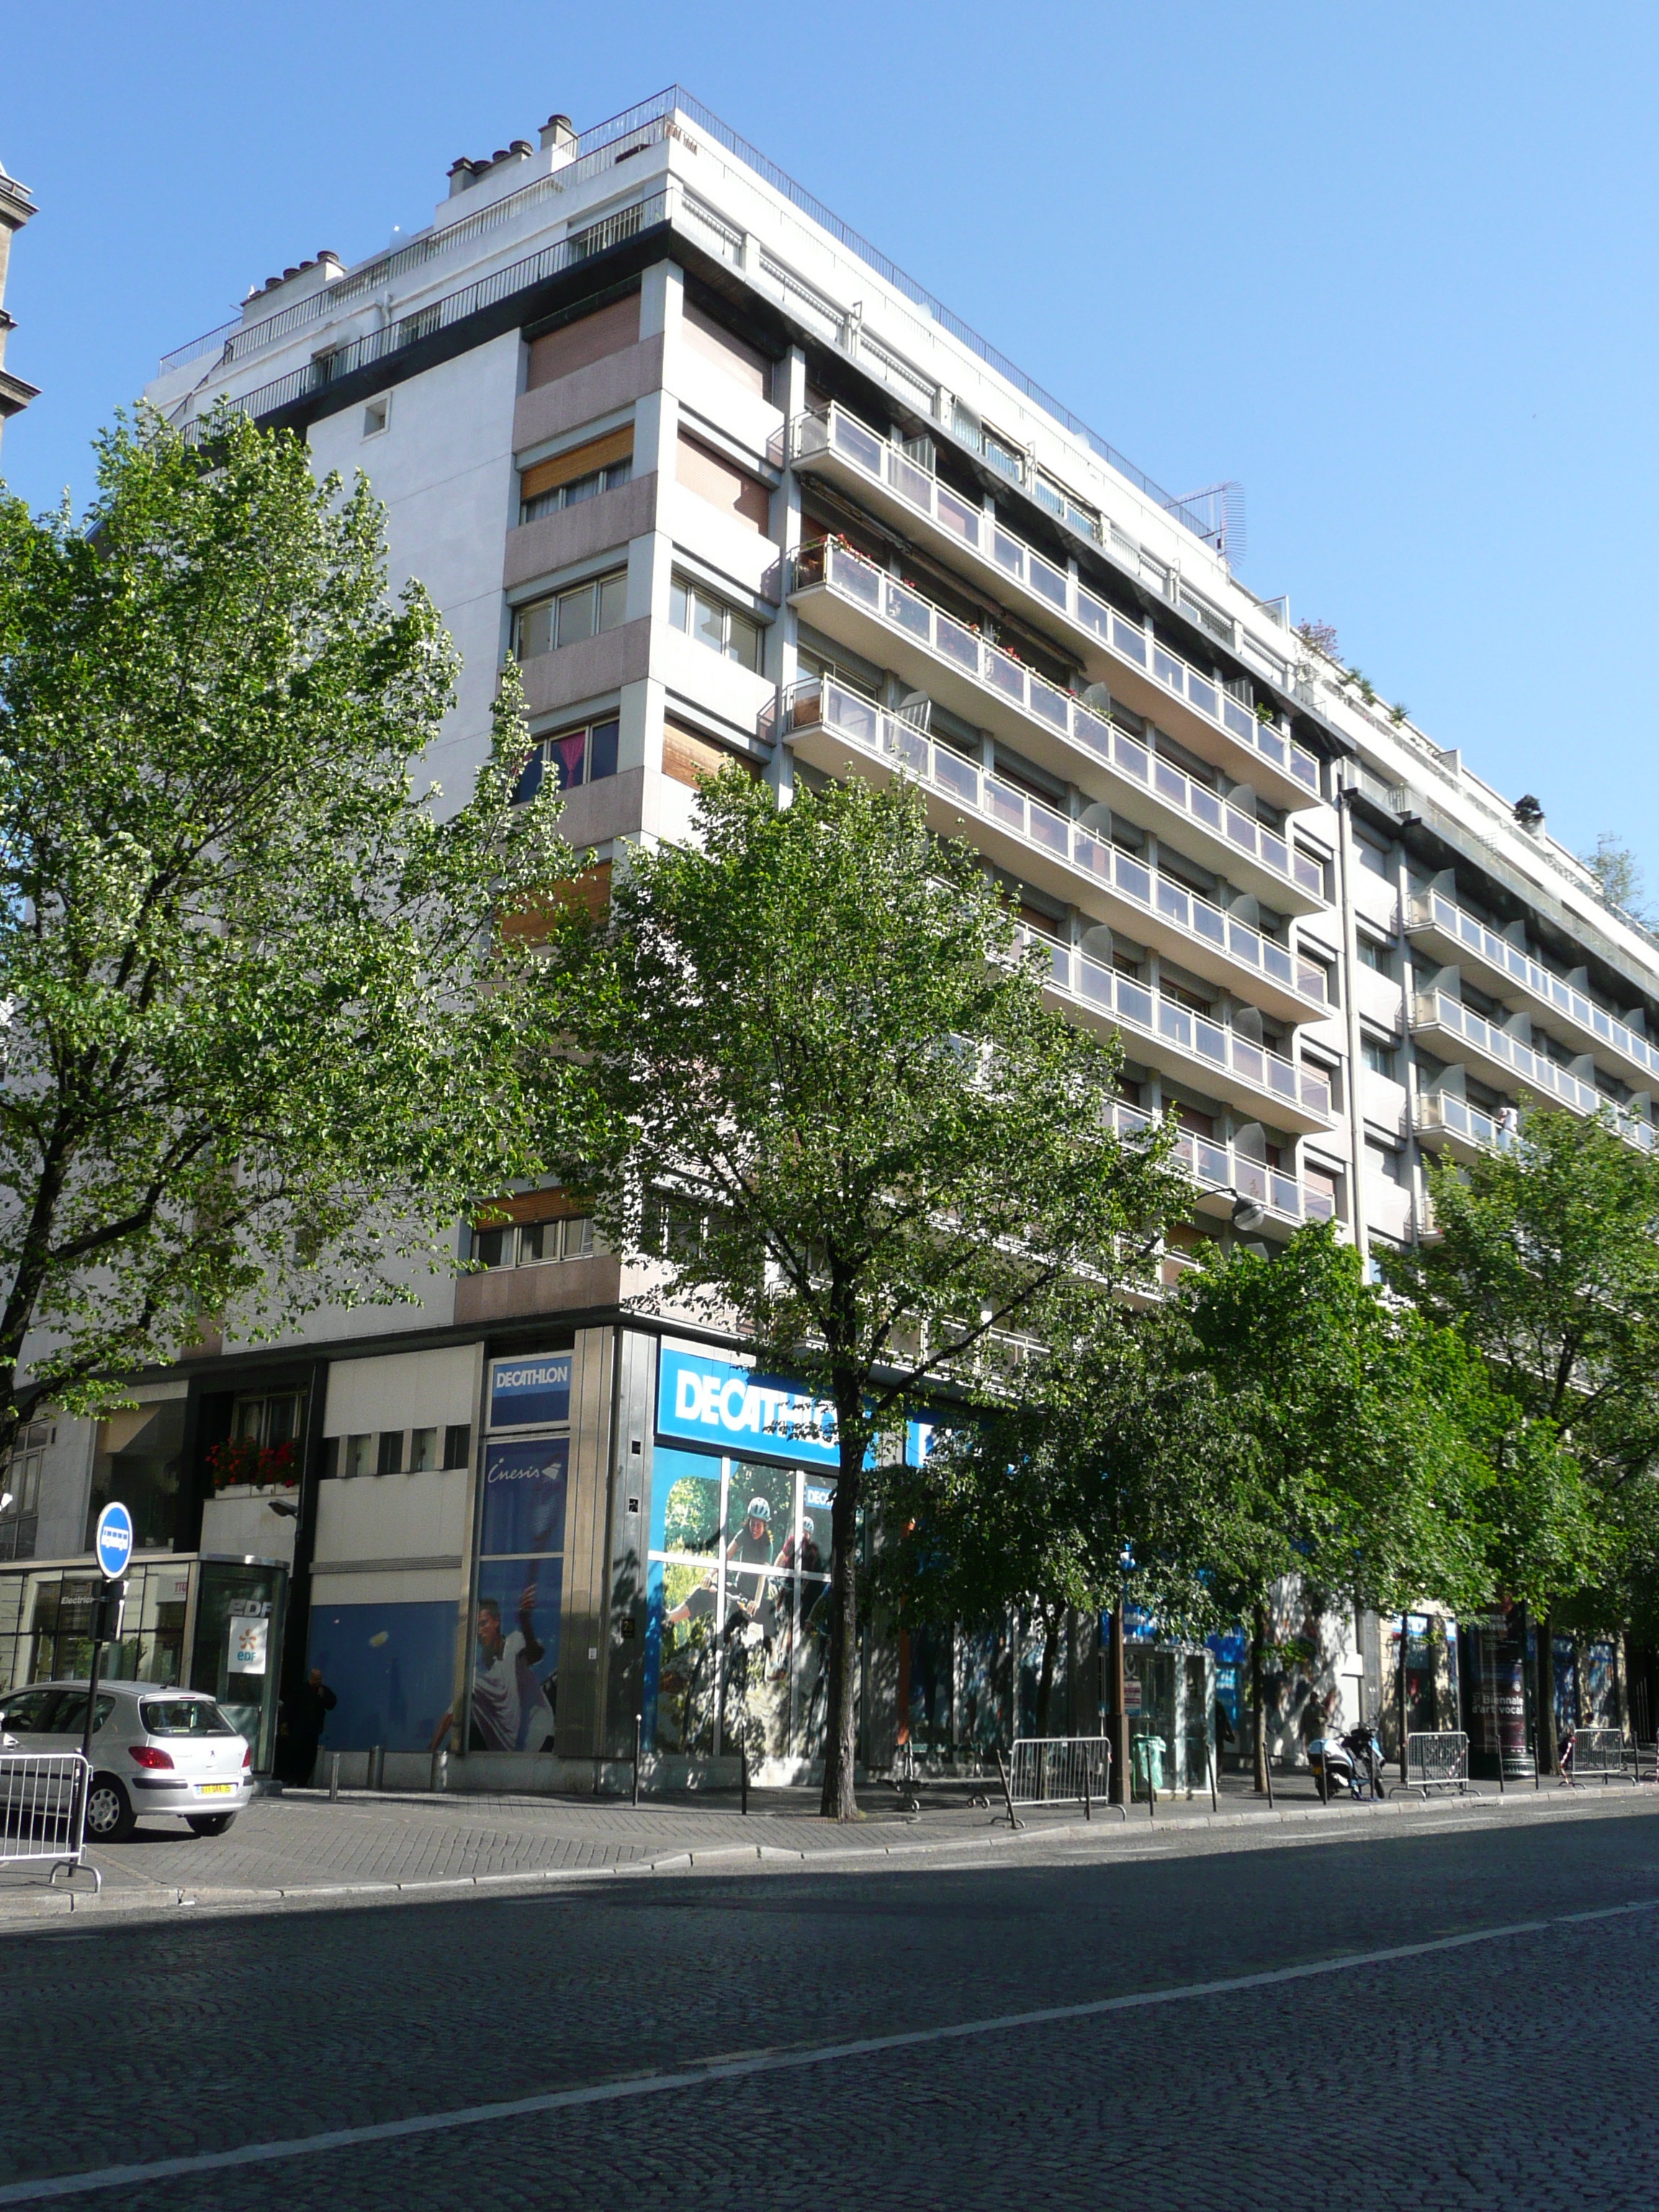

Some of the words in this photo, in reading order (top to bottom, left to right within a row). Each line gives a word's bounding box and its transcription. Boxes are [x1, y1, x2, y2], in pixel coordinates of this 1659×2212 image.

[496, 1366, 567, 1388] DECATHLON
[675, 1370, 840, 1449] DECATHLO
[1483, 1696, 1524, 1705] Biennale
[1498, 1705, 1524, 1714] vocal
